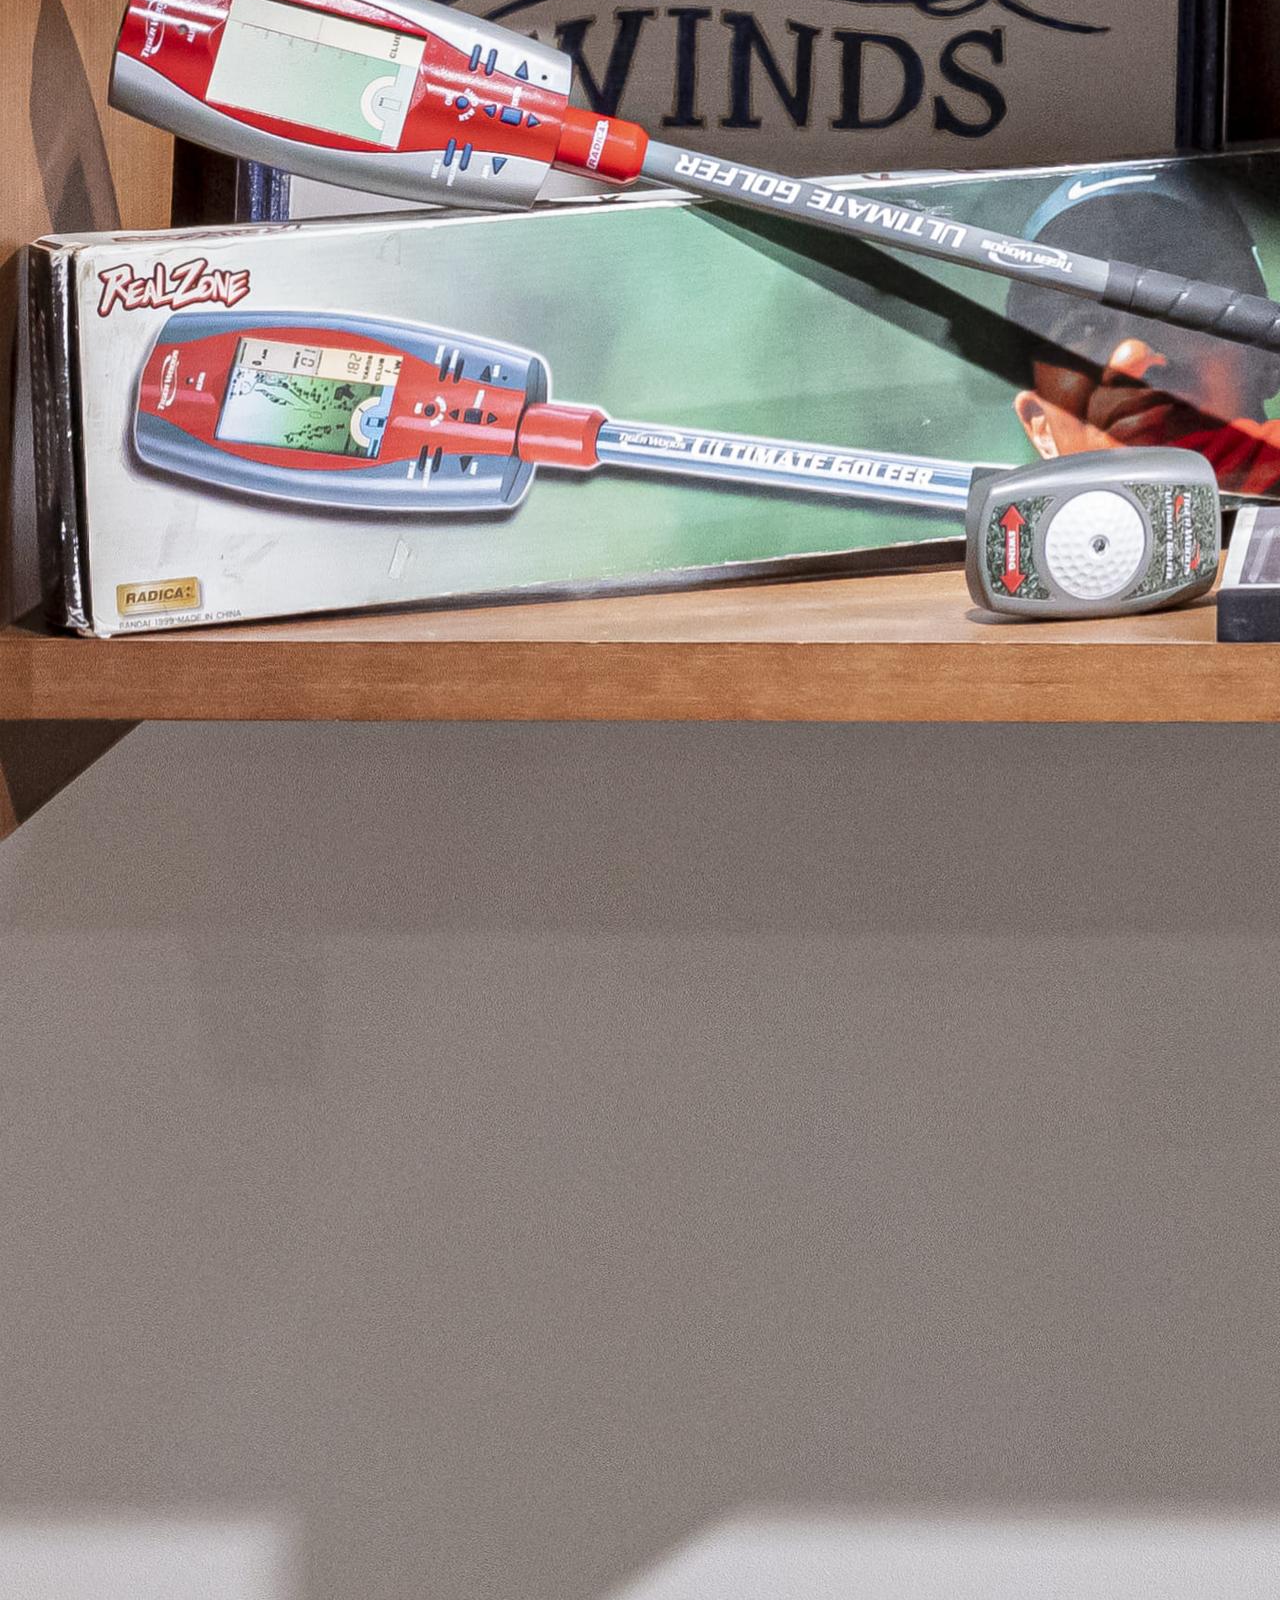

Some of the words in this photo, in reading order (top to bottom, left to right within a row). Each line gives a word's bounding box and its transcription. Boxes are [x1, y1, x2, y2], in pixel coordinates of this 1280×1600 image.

[674, 153, 803, 204] GOLFER
[807, 189, 968, 248] ULTIMATE
[1033, 252, 1074, 274] TIGER
[691, 437, 827, 471] ULTIMATE
[833, 457, 935, 486] GOLFER
[1008, 529, 1016, 571] SWING
[177, 614, 201, 624] MADE
[216, 610, 242, 619] CHINA
